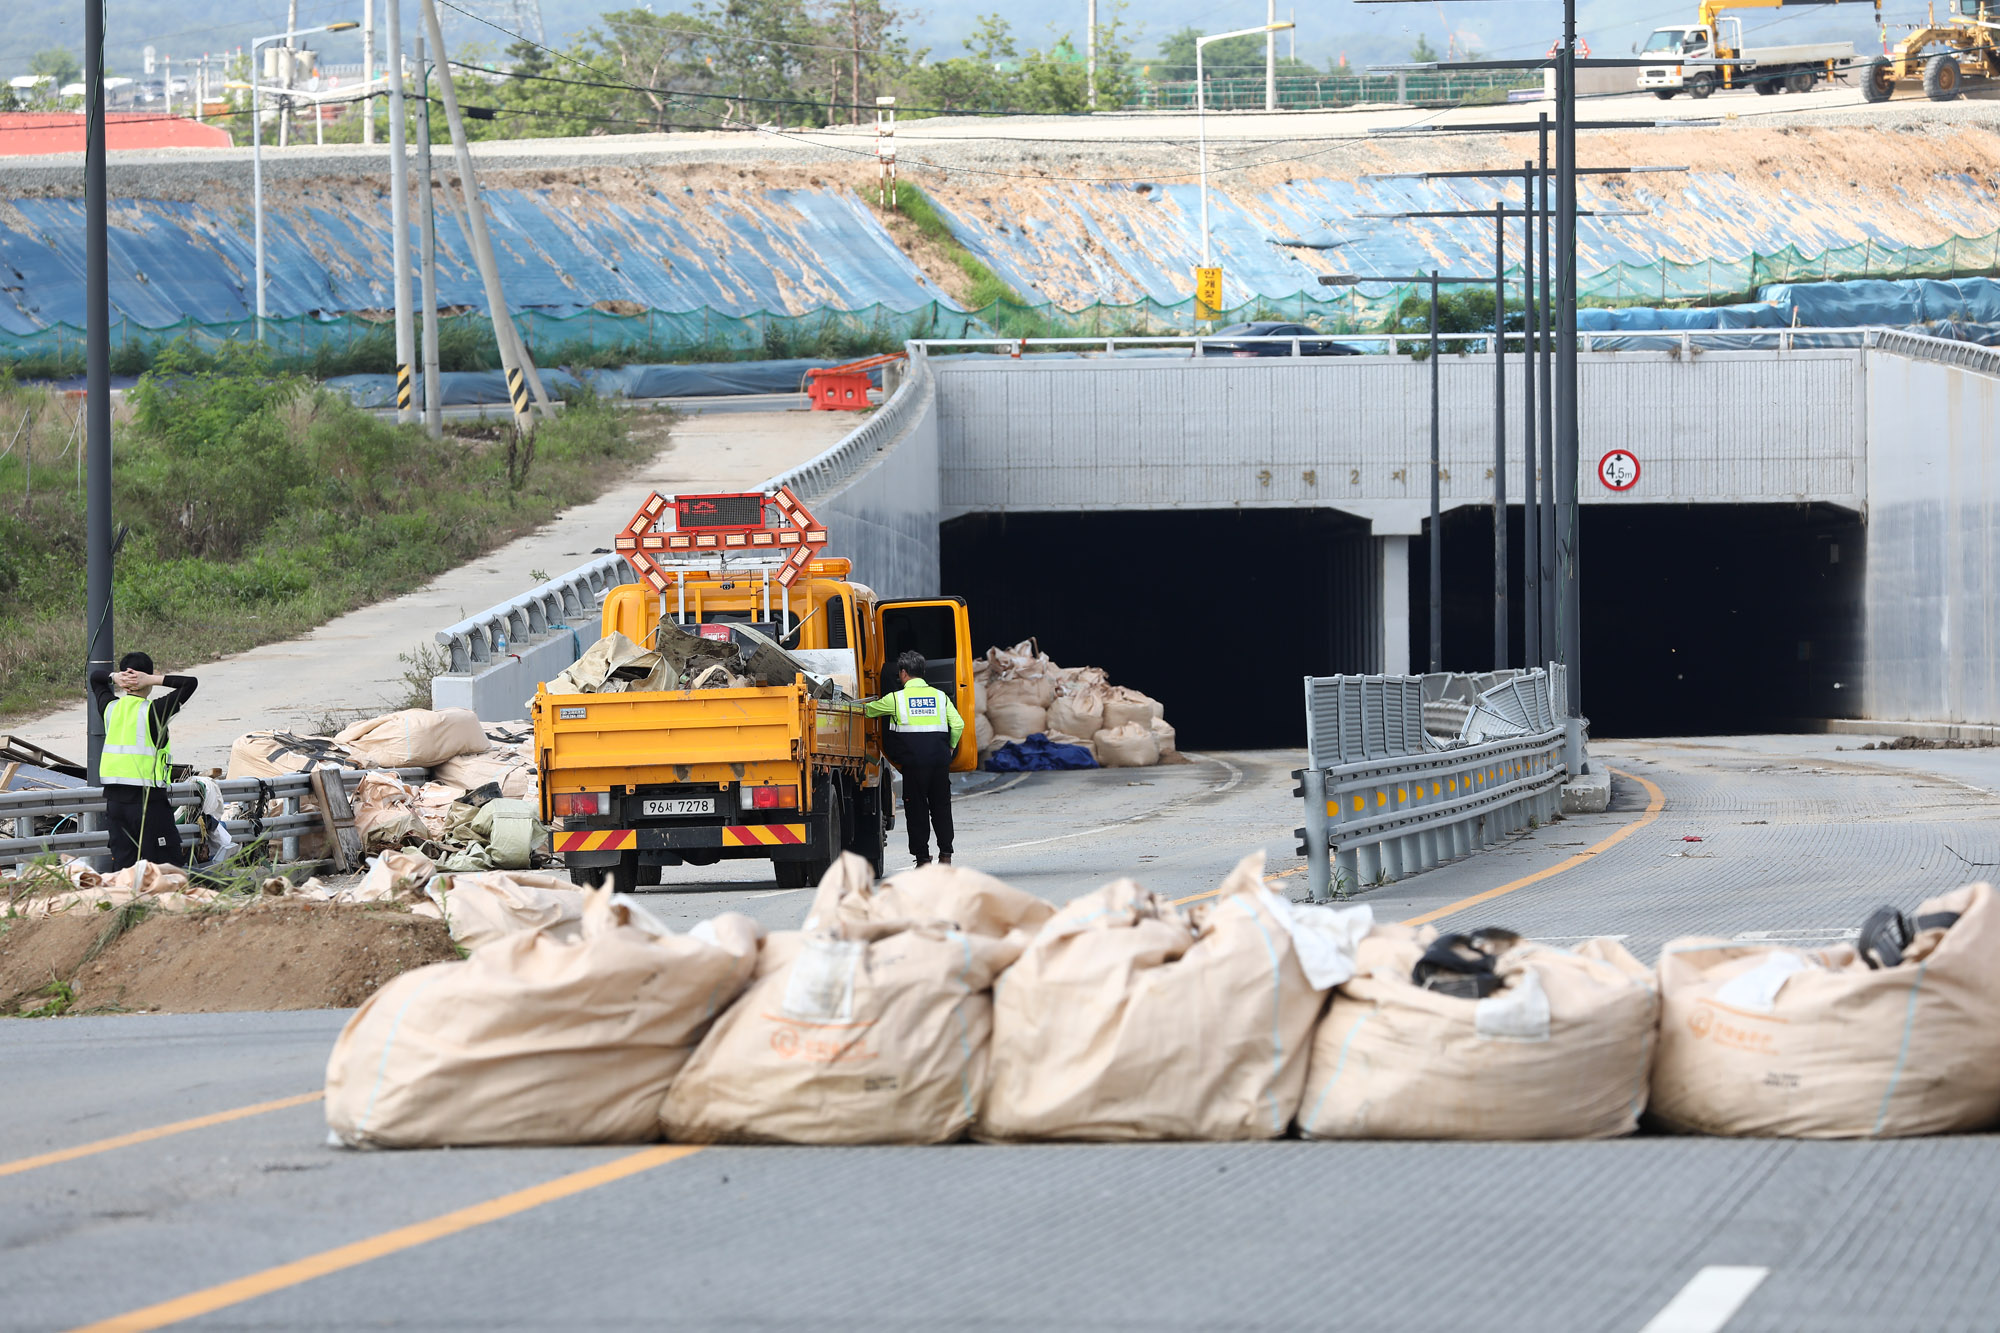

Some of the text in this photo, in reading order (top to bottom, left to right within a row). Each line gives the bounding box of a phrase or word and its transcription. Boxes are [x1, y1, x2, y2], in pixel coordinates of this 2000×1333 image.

[1605, 461, 1633, 480] 4.5m
[910, 698, 935, 708] 충청북도
[649, 800, 709, 813] 96서 7278
